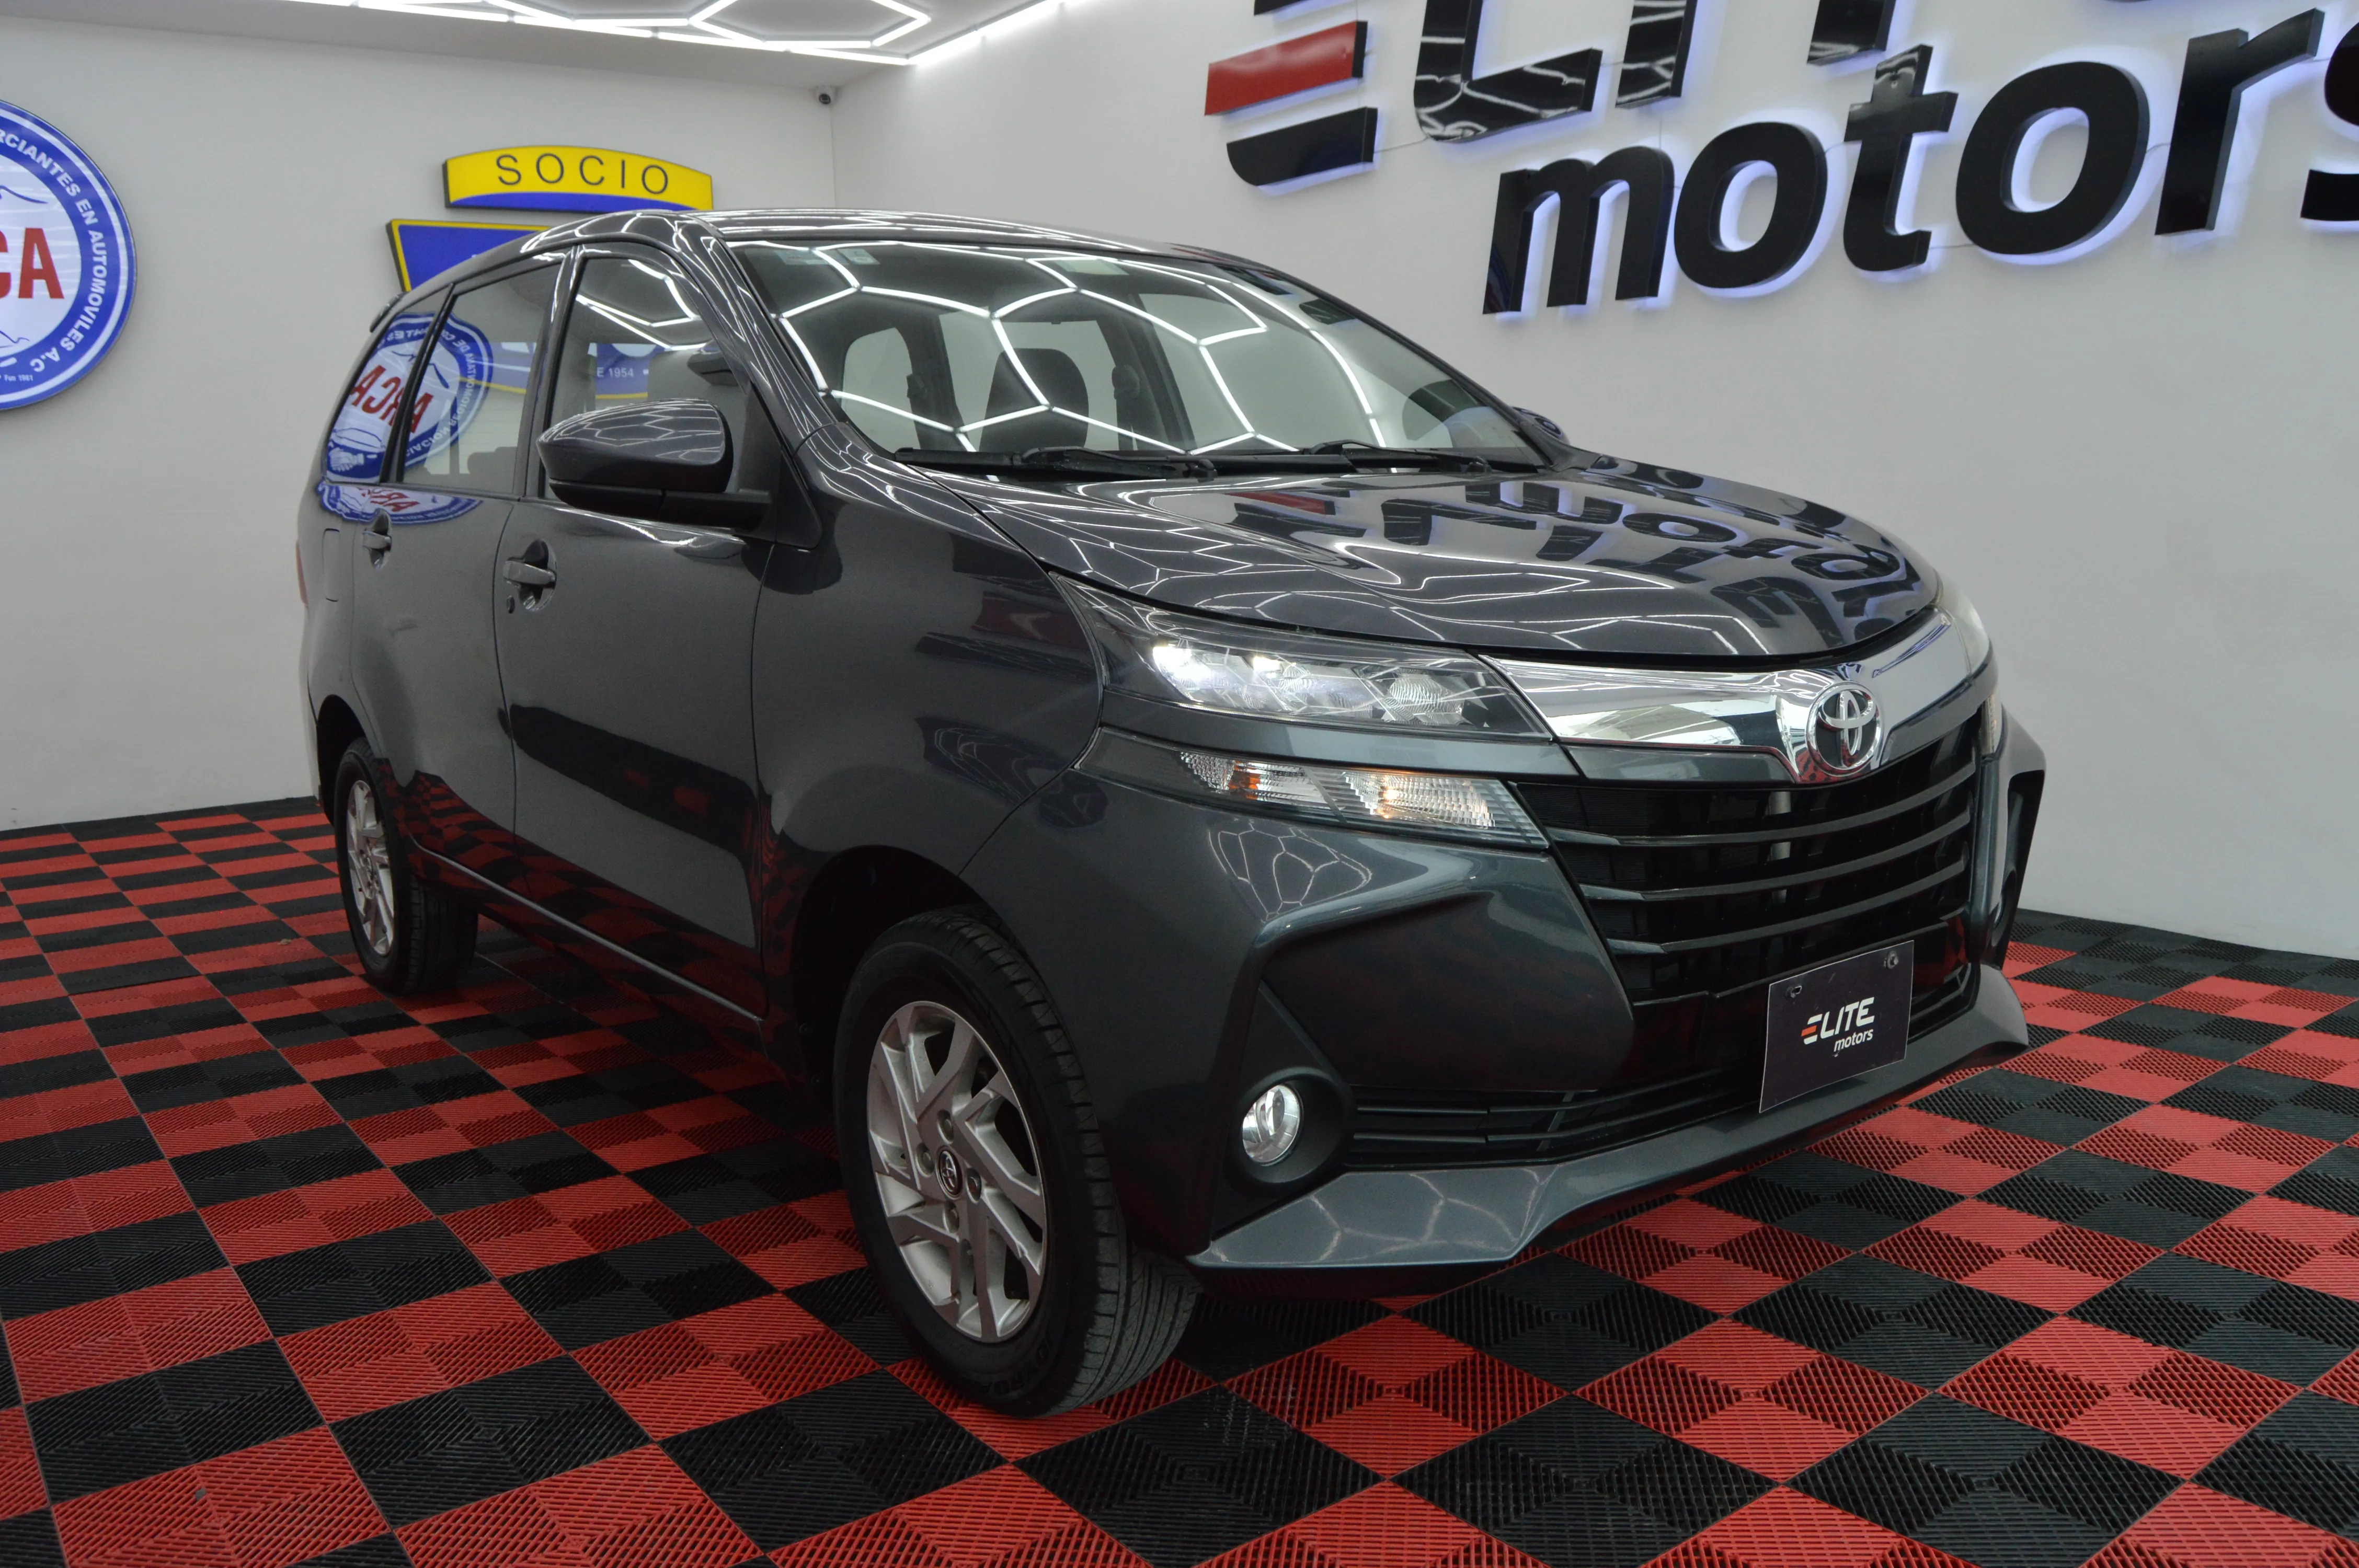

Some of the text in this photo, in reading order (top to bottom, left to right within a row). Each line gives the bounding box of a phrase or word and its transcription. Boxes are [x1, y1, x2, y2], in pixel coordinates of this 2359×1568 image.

[496, 153, 668, 194] SOCIO
[75, 199, 99, 225] EN
[60, 230, 107, 351] AUTOMOVILES
[609, 367, 634, 378] 1954
[1801, 997, 1875, 1045] ELITE
[1834, 1029, 1874, 1052] motors
